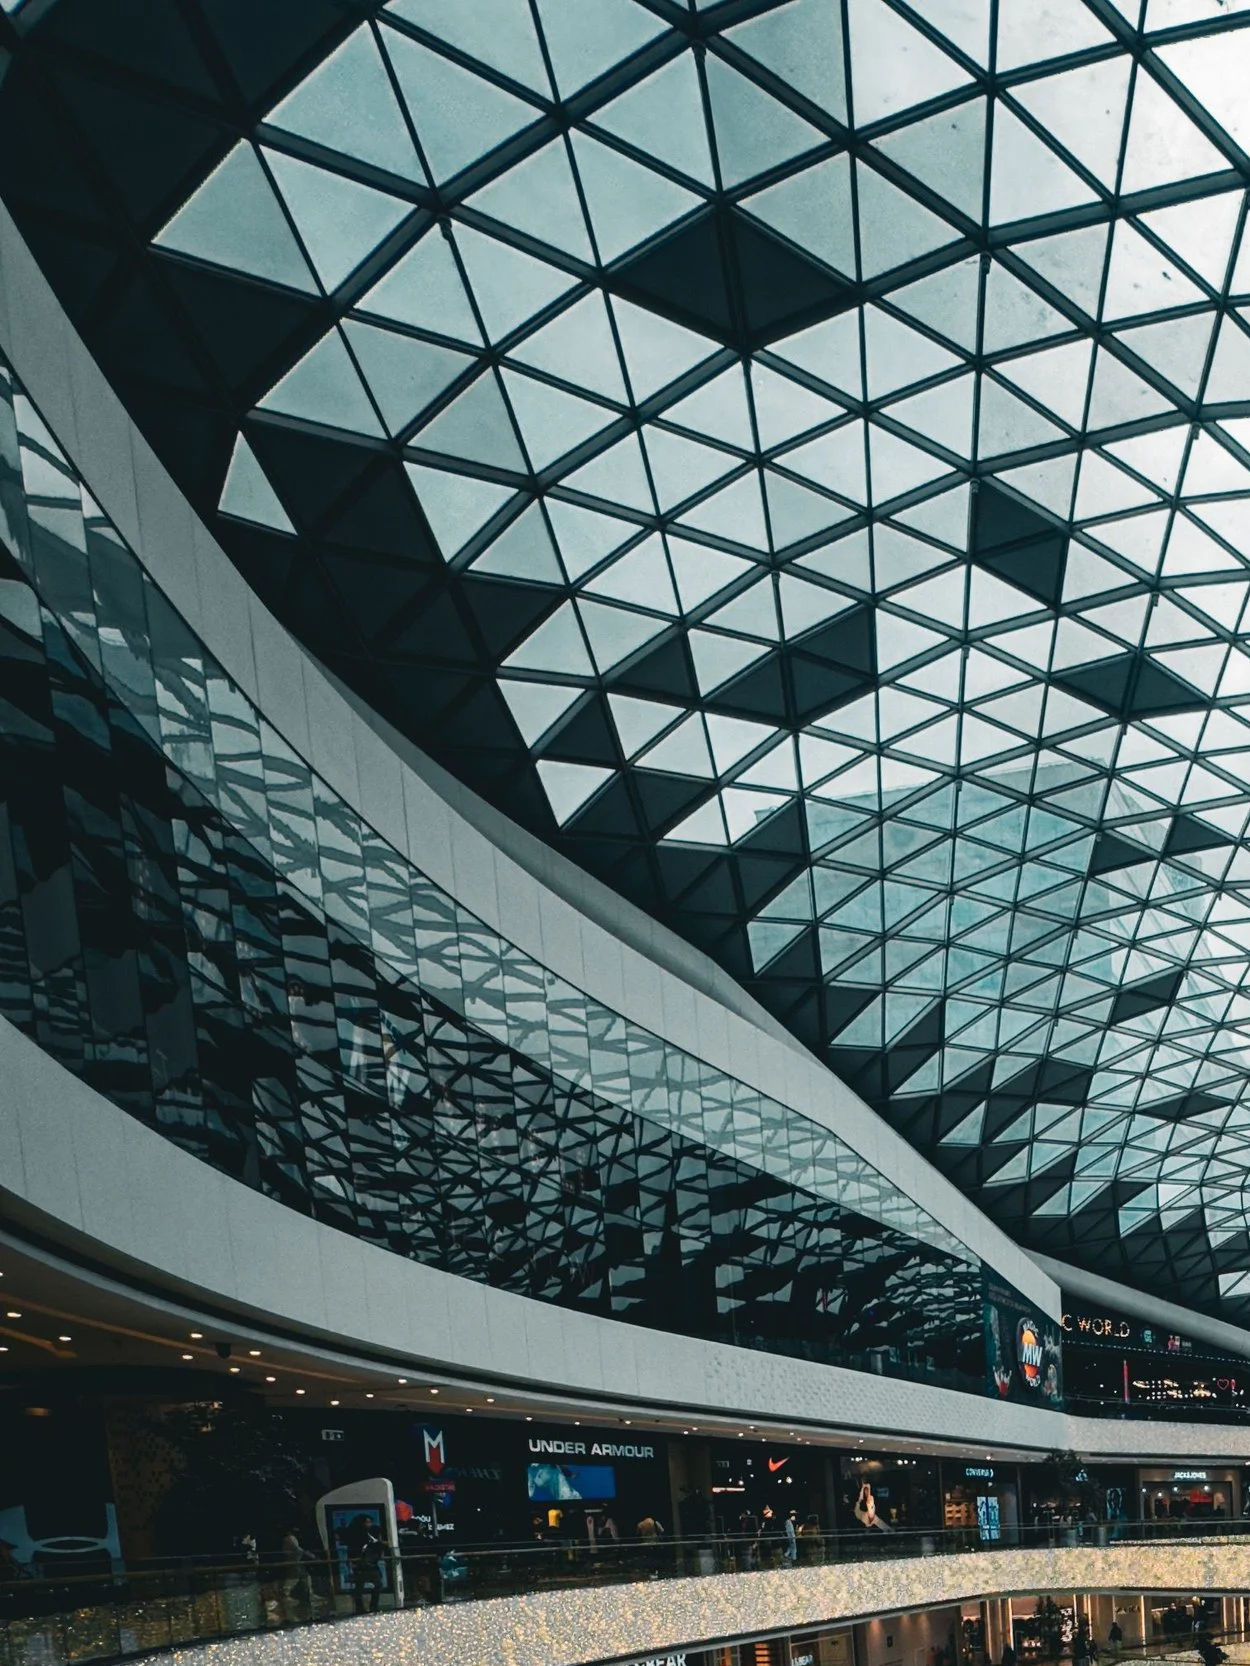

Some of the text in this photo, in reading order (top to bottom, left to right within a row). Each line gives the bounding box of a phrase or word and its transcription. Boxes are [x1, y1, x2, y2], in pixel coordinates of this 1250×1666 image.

[1061, 1314, 1073, 1332] C
[1022, 1342, 1043, 1367] MW
[528, 1438, 654, 1459] UNDER ARMOUR
